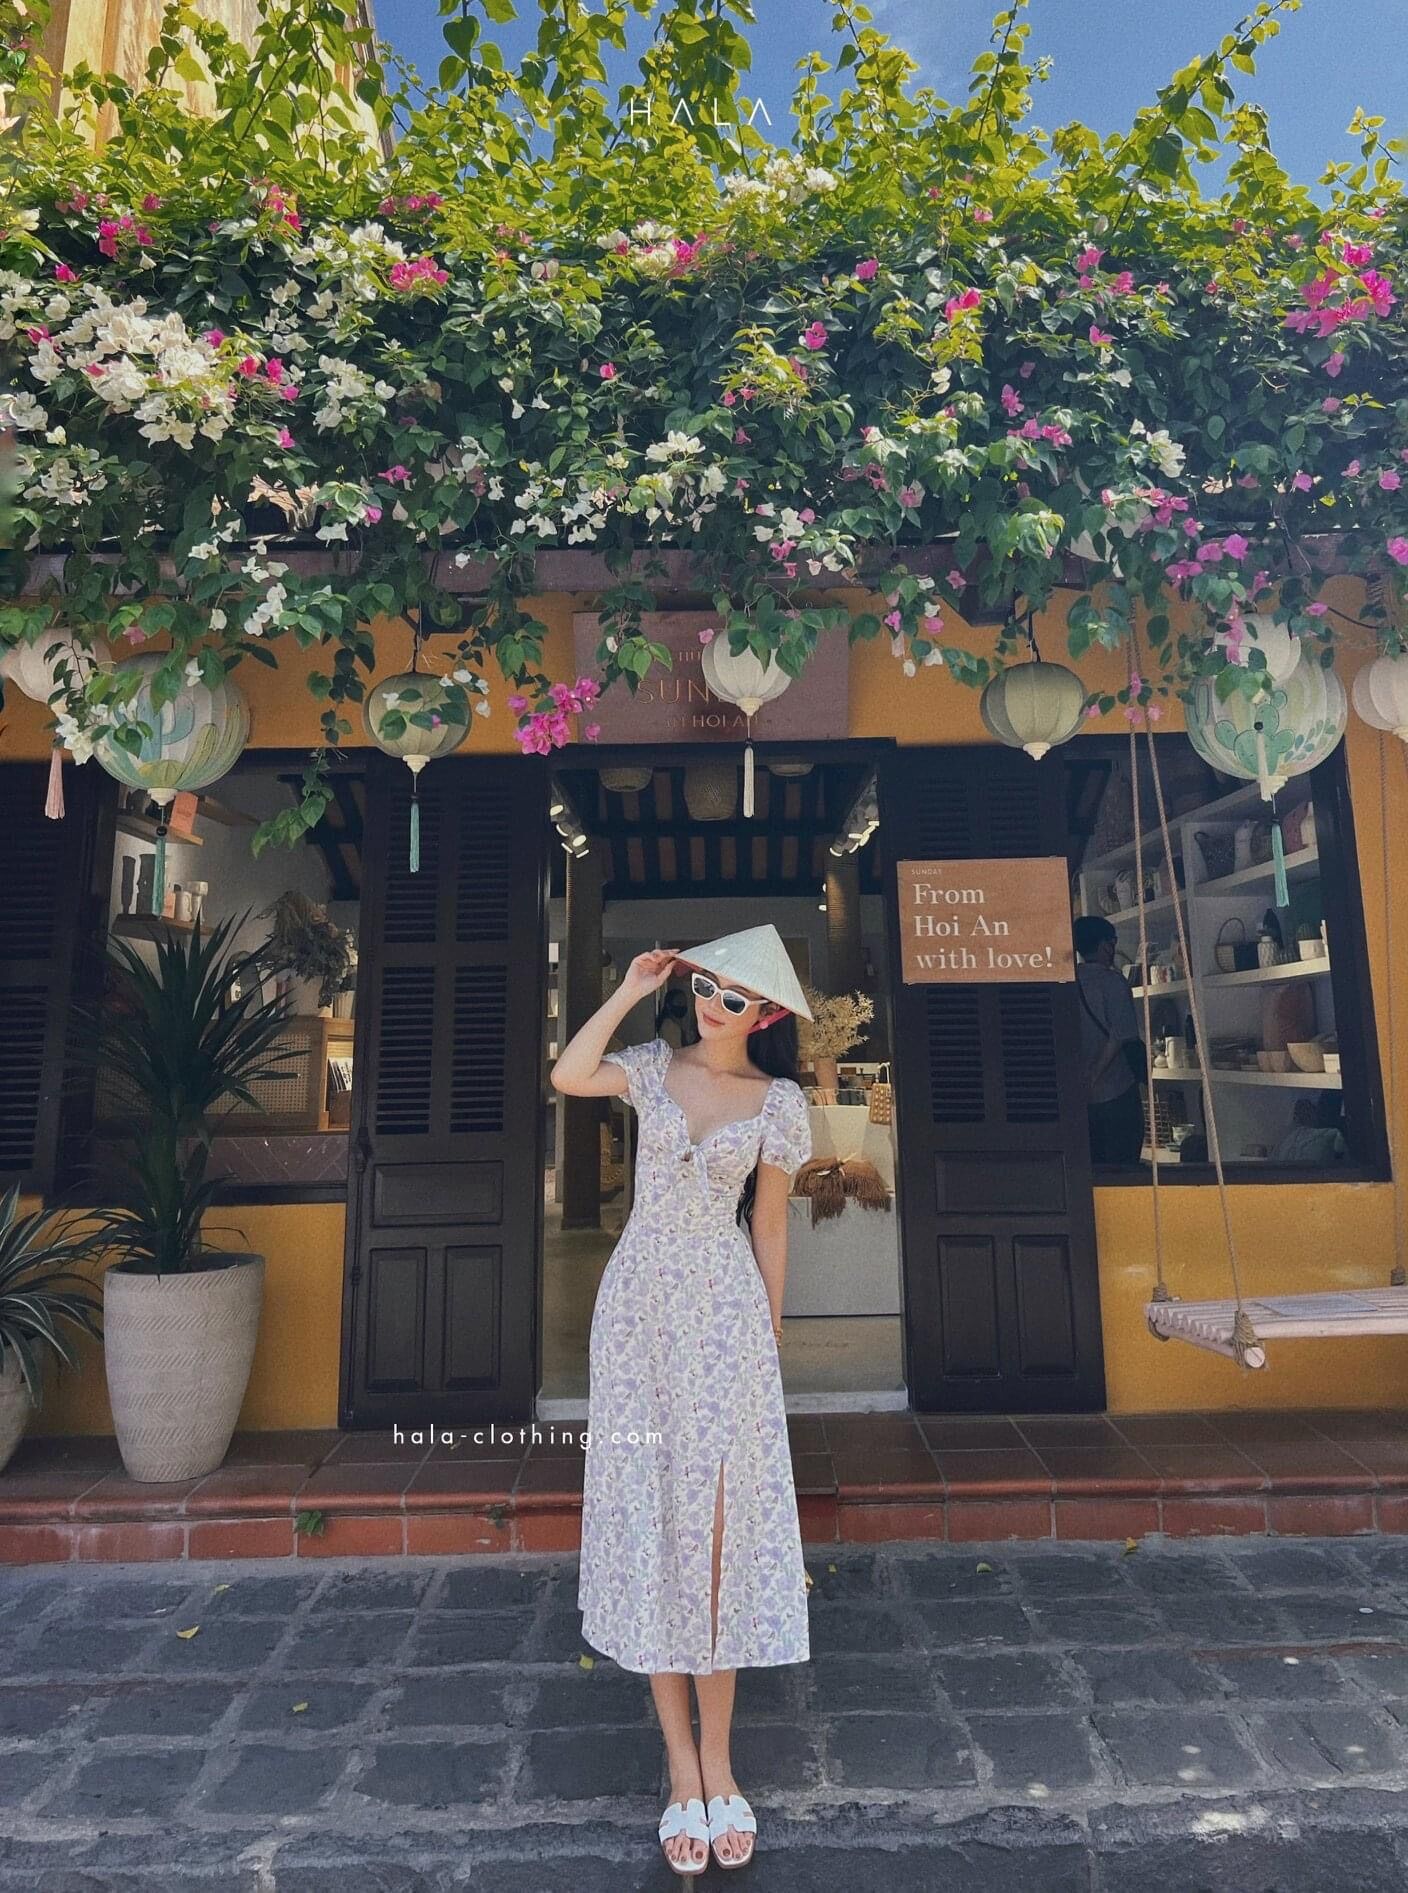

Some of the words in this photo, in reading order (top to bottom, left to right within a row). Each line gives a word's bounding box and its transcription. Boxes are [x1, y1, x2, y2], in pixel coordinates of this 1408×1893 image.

[692, 714, 726, 729] HOI
[913, 883, 985, 905] From
[913, 915, 960, 937] Hoi
[970, 914, 1010, 936] An
[915, 948, 978, 969] with
[987, 946, 1053, 969] love!
